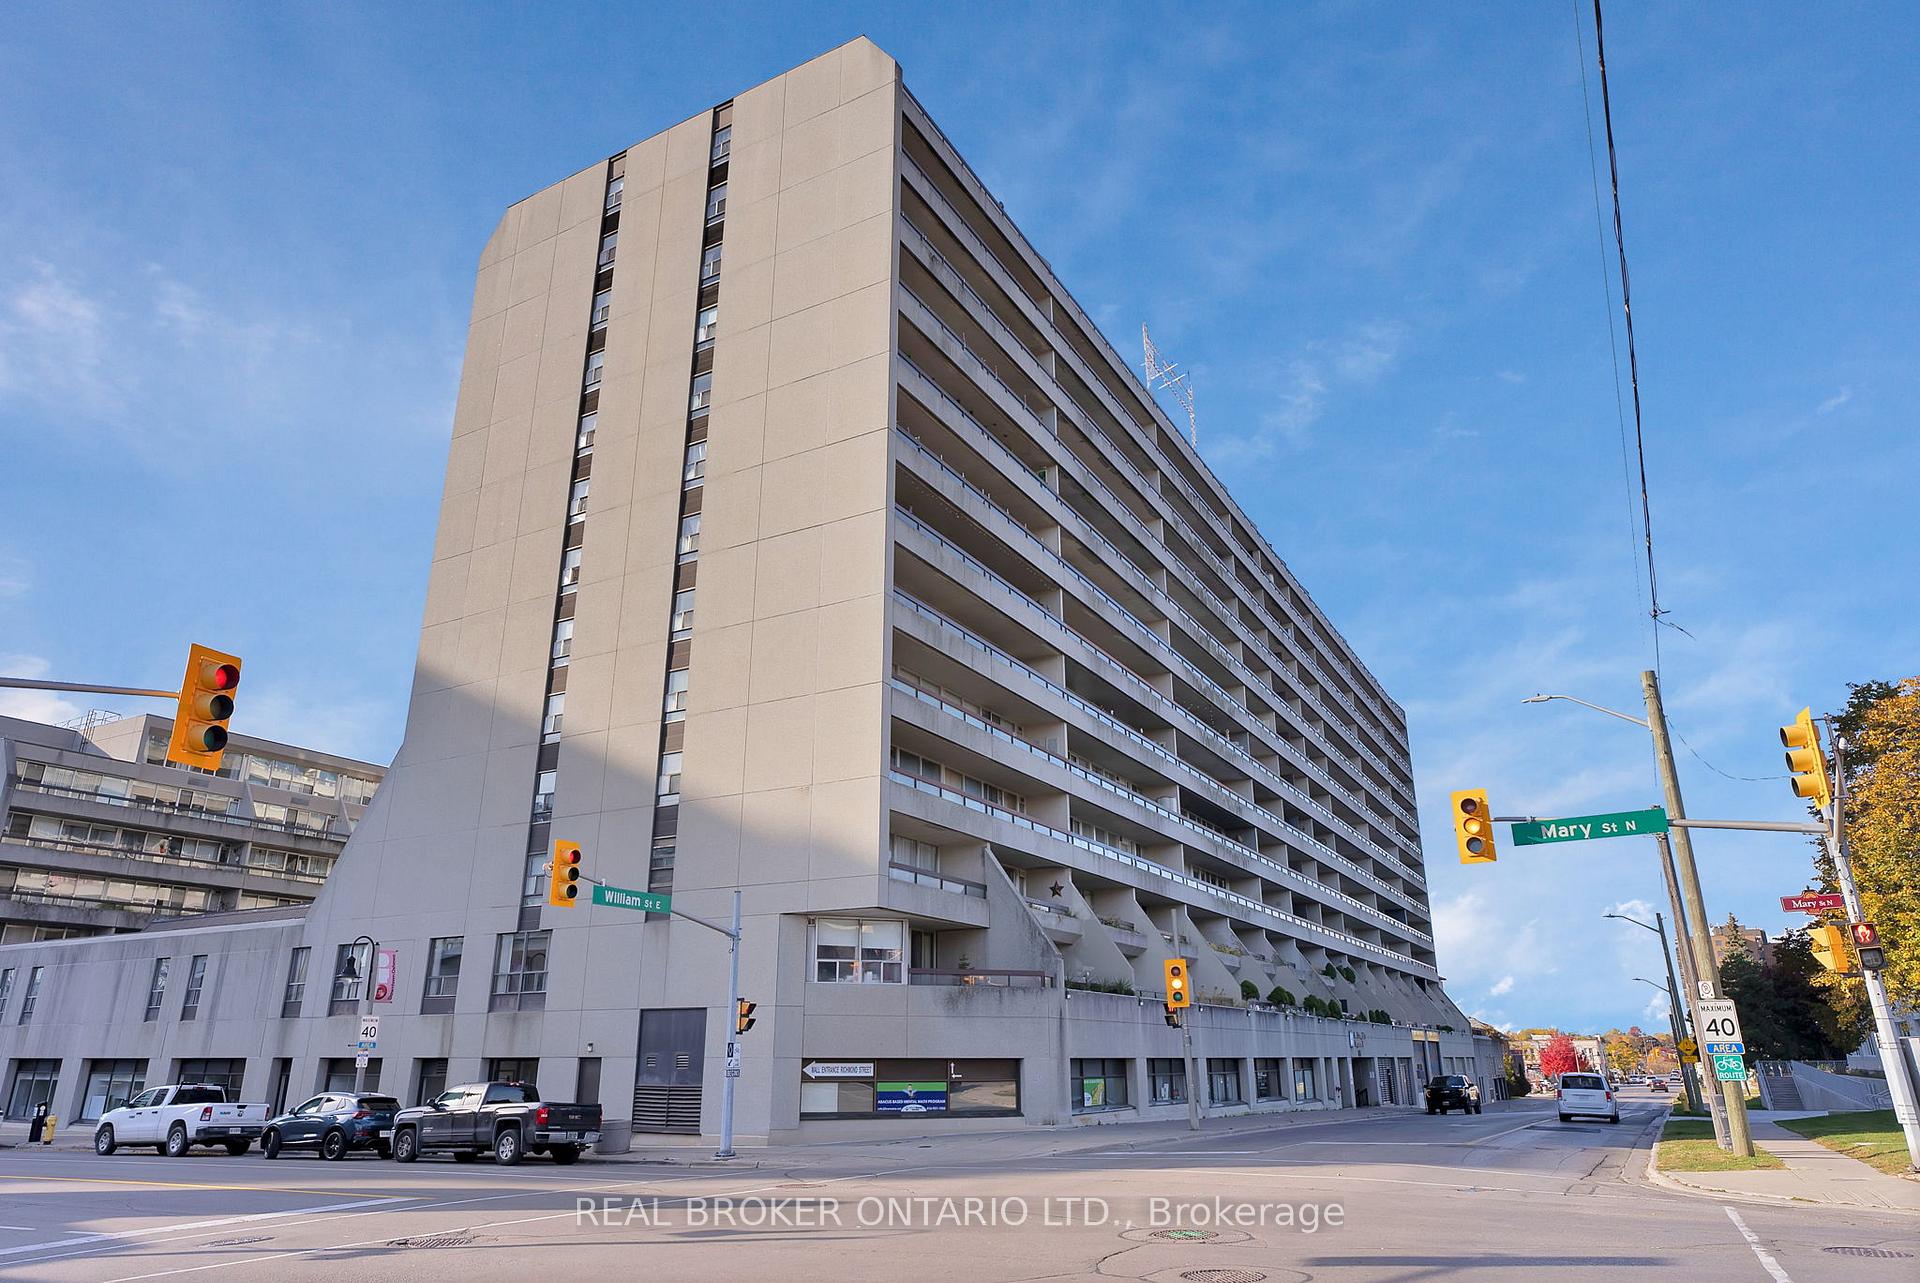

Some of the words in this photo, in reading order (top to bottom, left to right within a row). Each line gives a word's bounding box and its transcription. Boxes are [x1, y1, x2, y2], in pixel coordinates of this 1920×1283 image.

[1541, 823, 1592, 839] Mary
[1602, 822, 1618, 833] St
[1625, 820, 1637, 831] N
[604, 890, 641, 907] William
[644, 899, 653, 908] St
[655, 901, 662, 909] E
[1791, 899, 1817, 909] Mary
[1700, 1004, 1733, 1012] MAXIMUM
[361, 1026, 377, 1038] 40
[1706, 1018, 1735, 1036] 40
[1713, 1043, 1738, 1053] AREA
[1719, 1071, 1744, 1079] ROUTE
